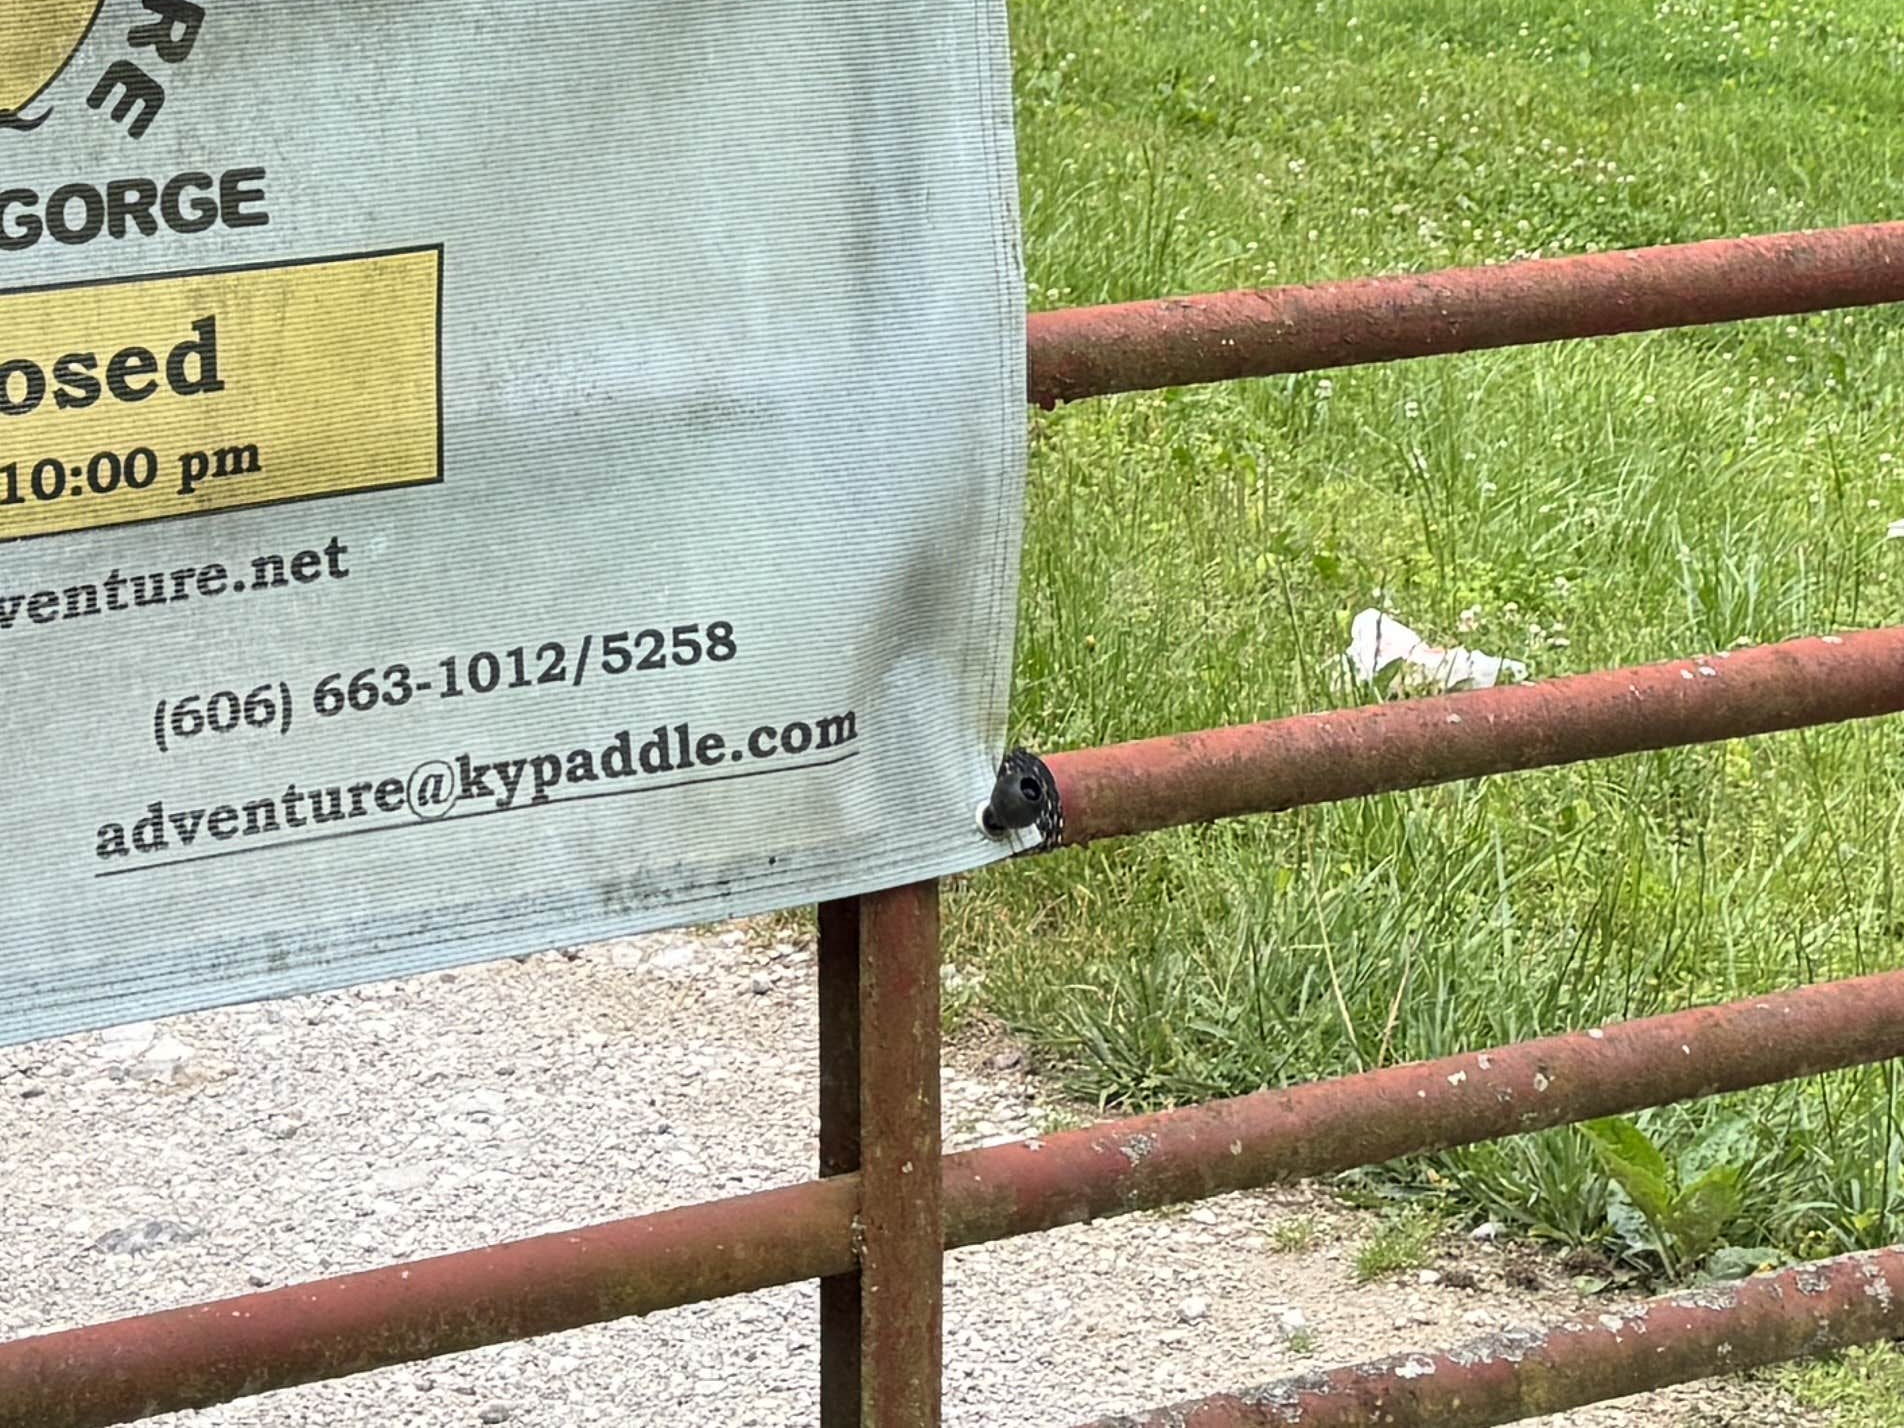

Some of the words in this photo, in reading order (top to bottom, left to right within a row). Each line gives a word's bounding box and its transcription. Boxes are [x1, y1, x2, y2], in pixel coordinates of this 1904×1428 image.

[180, 440, 262, 494] pm
[155, 681, 293, 752] (606)
[312, 620, 737, 717] 663-1012/5258
[96, 708, 858, 861] adventure@kypaddle.com
